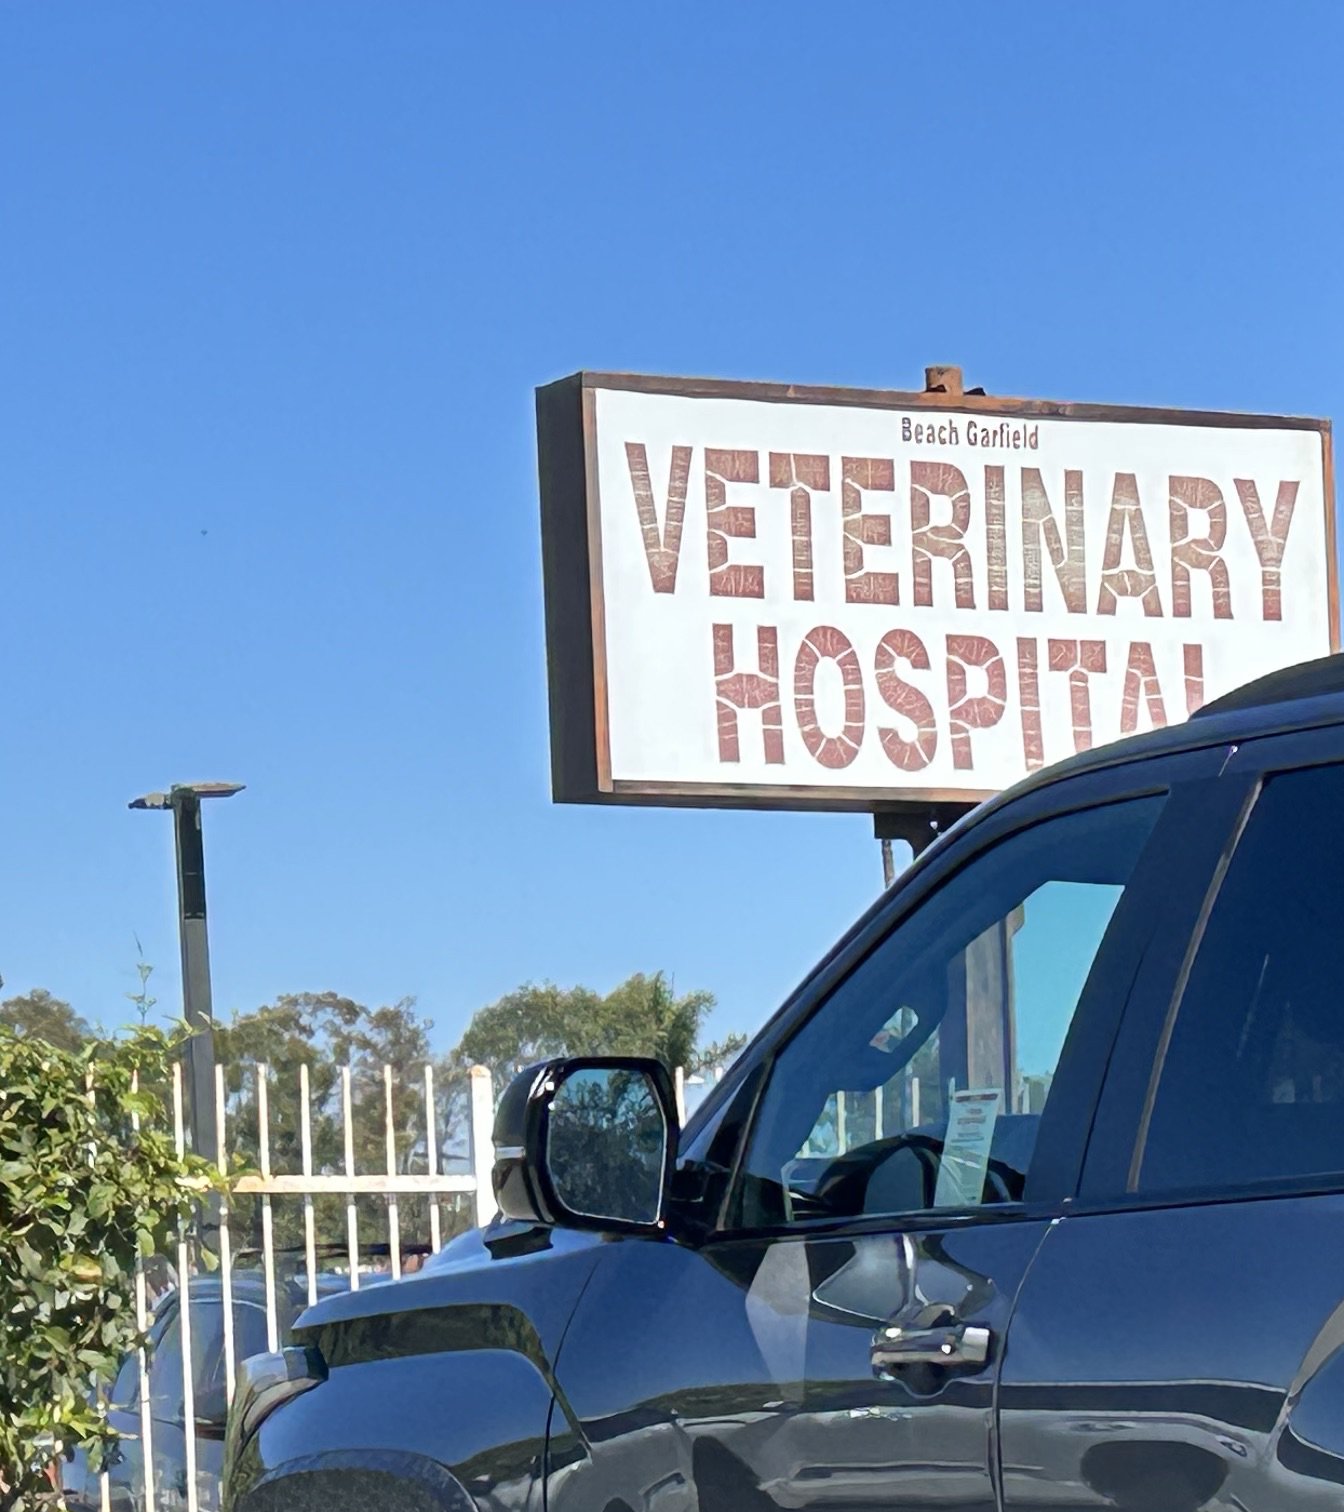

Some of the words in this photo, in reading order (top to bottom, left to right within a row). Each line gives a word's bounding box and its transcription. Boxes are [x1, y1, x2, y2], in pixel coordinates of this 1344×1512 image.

[901, 416, 960, 446] Beach
[966, 420, 1040, 450] Garfield
[623, 441, 1301, 622] VETERINARY
